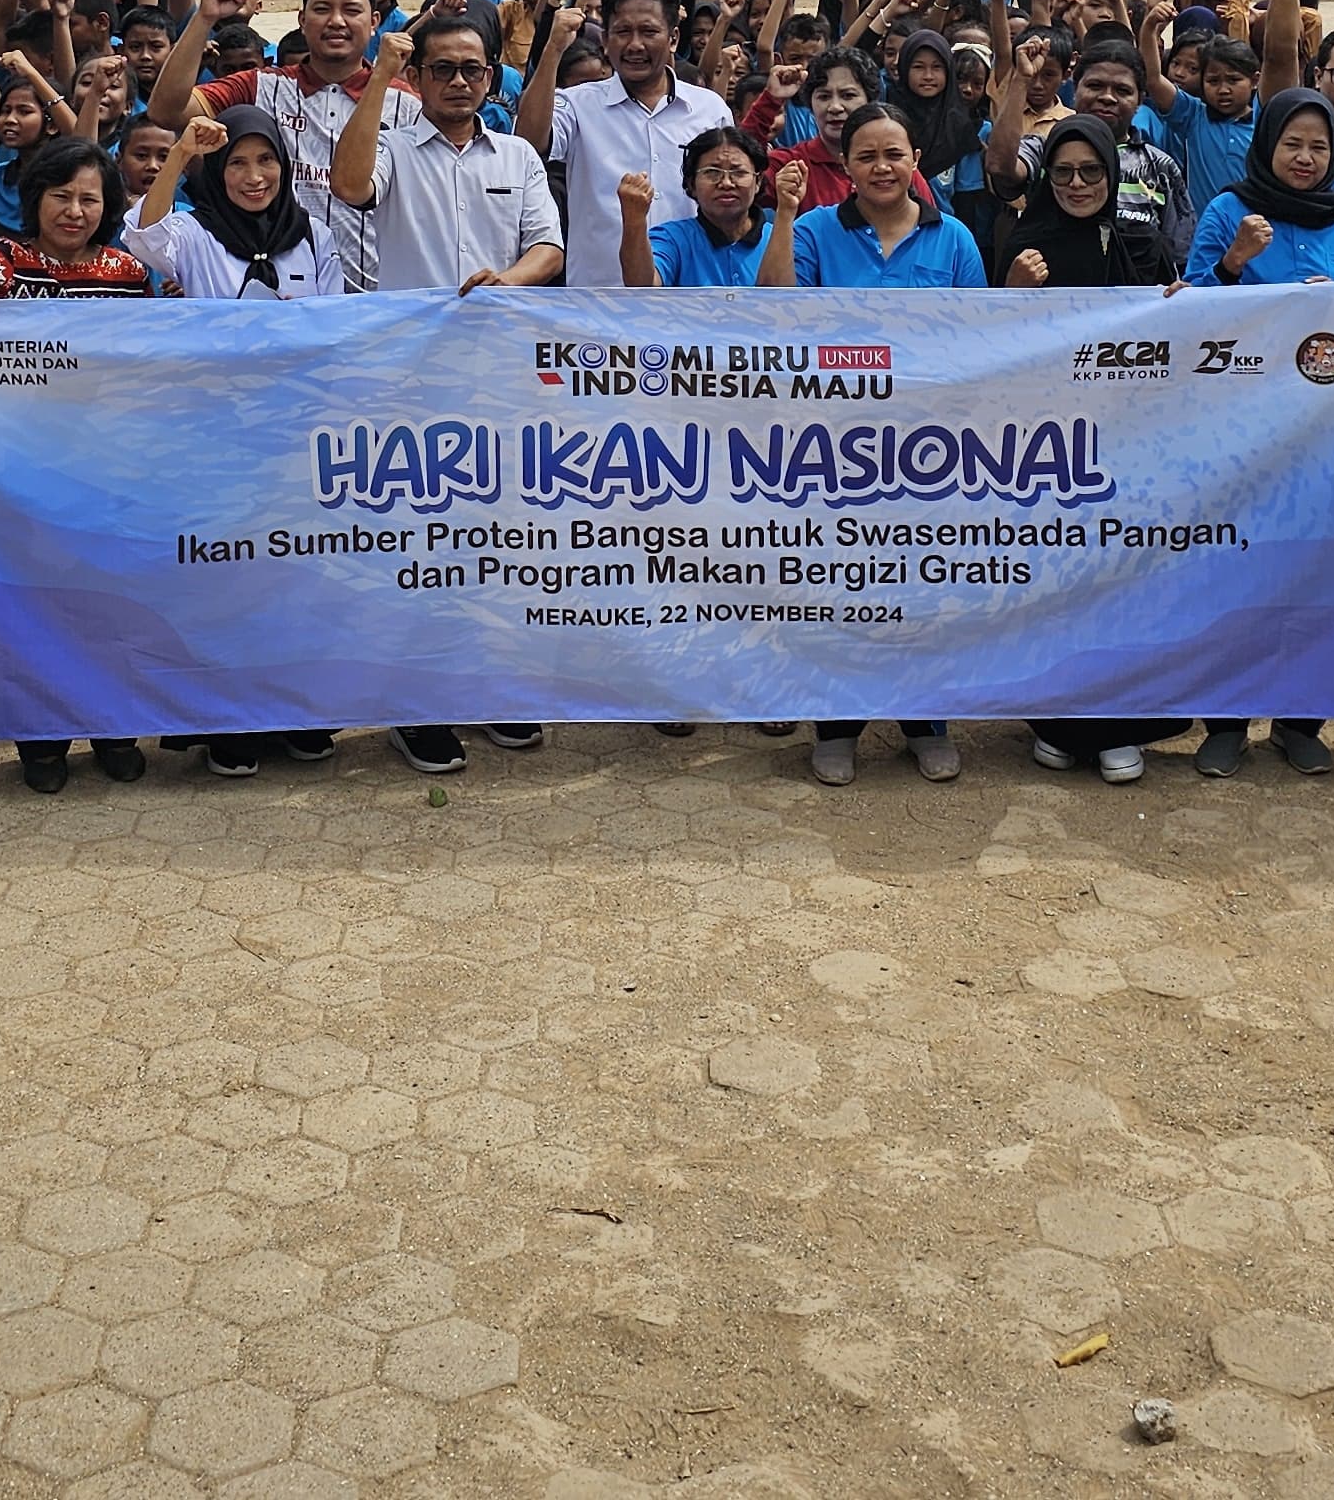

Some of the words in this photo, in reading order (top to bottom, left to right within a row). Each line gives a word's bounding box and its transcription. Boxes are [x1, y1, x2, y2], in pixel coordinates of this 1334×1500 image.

[43, 358, 79, 370] DAN
[535, 342, 714, 372] EKONOMI
[728, 346, 810, 373] BIRU
[824, 348, 886, 367] UNTUK
[1233, 355, 1265, 367] KKP
[571, 371, 779, 399] INDONESIA
[790, 373, 894, 401] MAJU
[1073, 371, 1102, 381] KKP
[1107, 369, 1170, 381] BEYOND
[314, 418, 500, 511] HARI
[520, 418, 710, 510] IKAN
[727, 416, 1117, 509] NASIONAL
[176, 534, 255, 565] Ikan
[267, 524, 416, 558] Sumber
[427, 520, 557, 552] Protein
[570, 520, 709, 554] Bangsa
[721, 517, 825, 548] untuk
[836, 516, 1087, 548] Swasembada
[1099, 518, 1250, 553] Pangan,
[397, 560, 465, 590] dan
[478, 556, 635, 595] Program
[647, 556, 766, 585] Makan
[779, 555, 907, 592] Bergizi
[919, 555, 1032, 585] Gratis
[526, 606, 652, 629] MERAUKE,
[659, 605, 688, 624] 22
[696, 603, 835, 623] NOVEMBER
[842, 605, 904, 624] 2024
